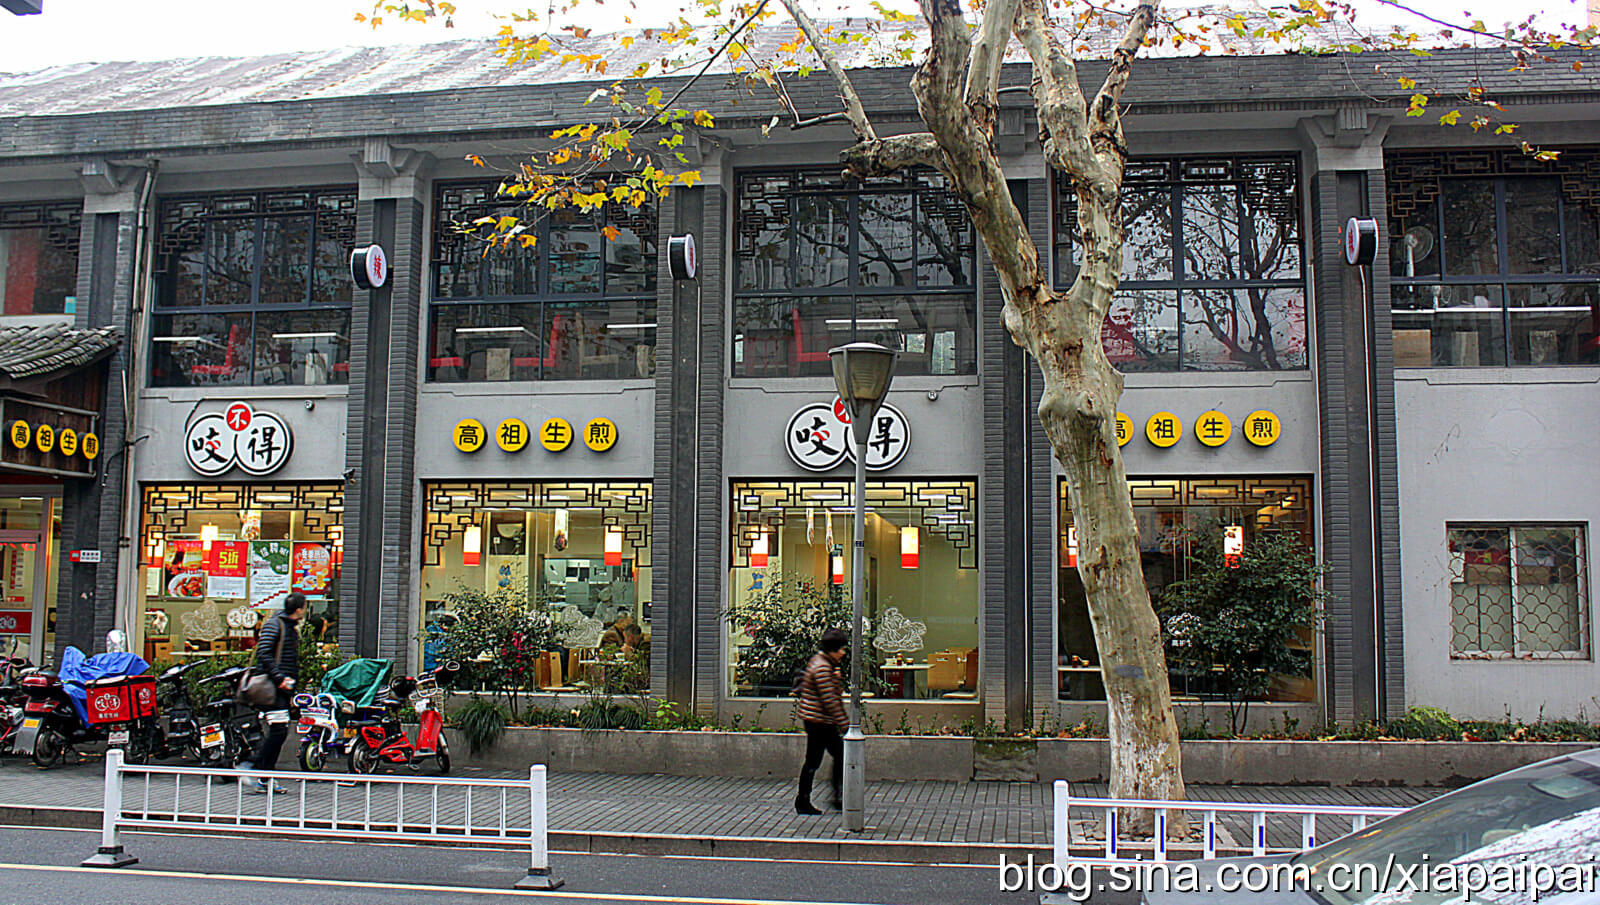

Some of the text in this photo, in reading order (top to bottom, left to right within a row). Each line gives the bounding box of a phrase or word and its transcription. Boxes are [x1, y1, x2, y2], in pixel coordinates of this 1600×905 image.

[15, 425, 97, 454] 高祖生煎
[458, 422, 610, 446] 高祖生煎
